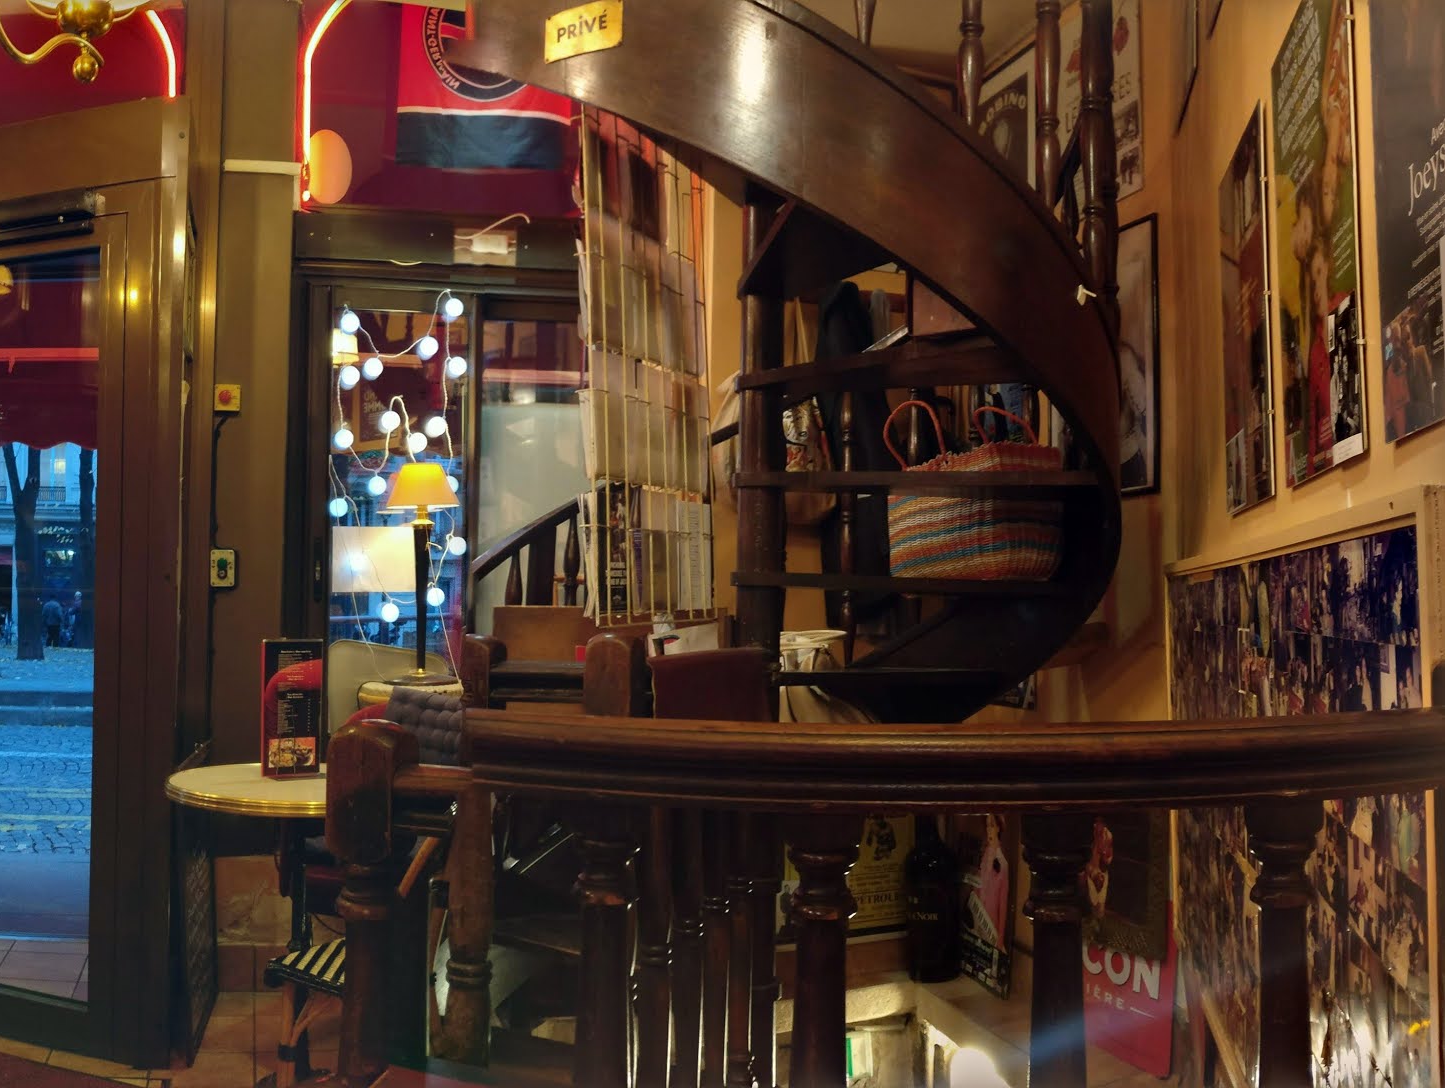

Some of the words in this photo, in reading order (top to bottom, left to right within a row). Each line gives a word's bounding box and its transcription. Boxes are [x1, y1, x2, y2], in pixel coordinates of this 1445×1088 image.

[557, 9, 607, 43] PRIVÉ
[1082, 939, 1161, 1000] CON
[1086, 983, 1124, 1011] IÈRE
